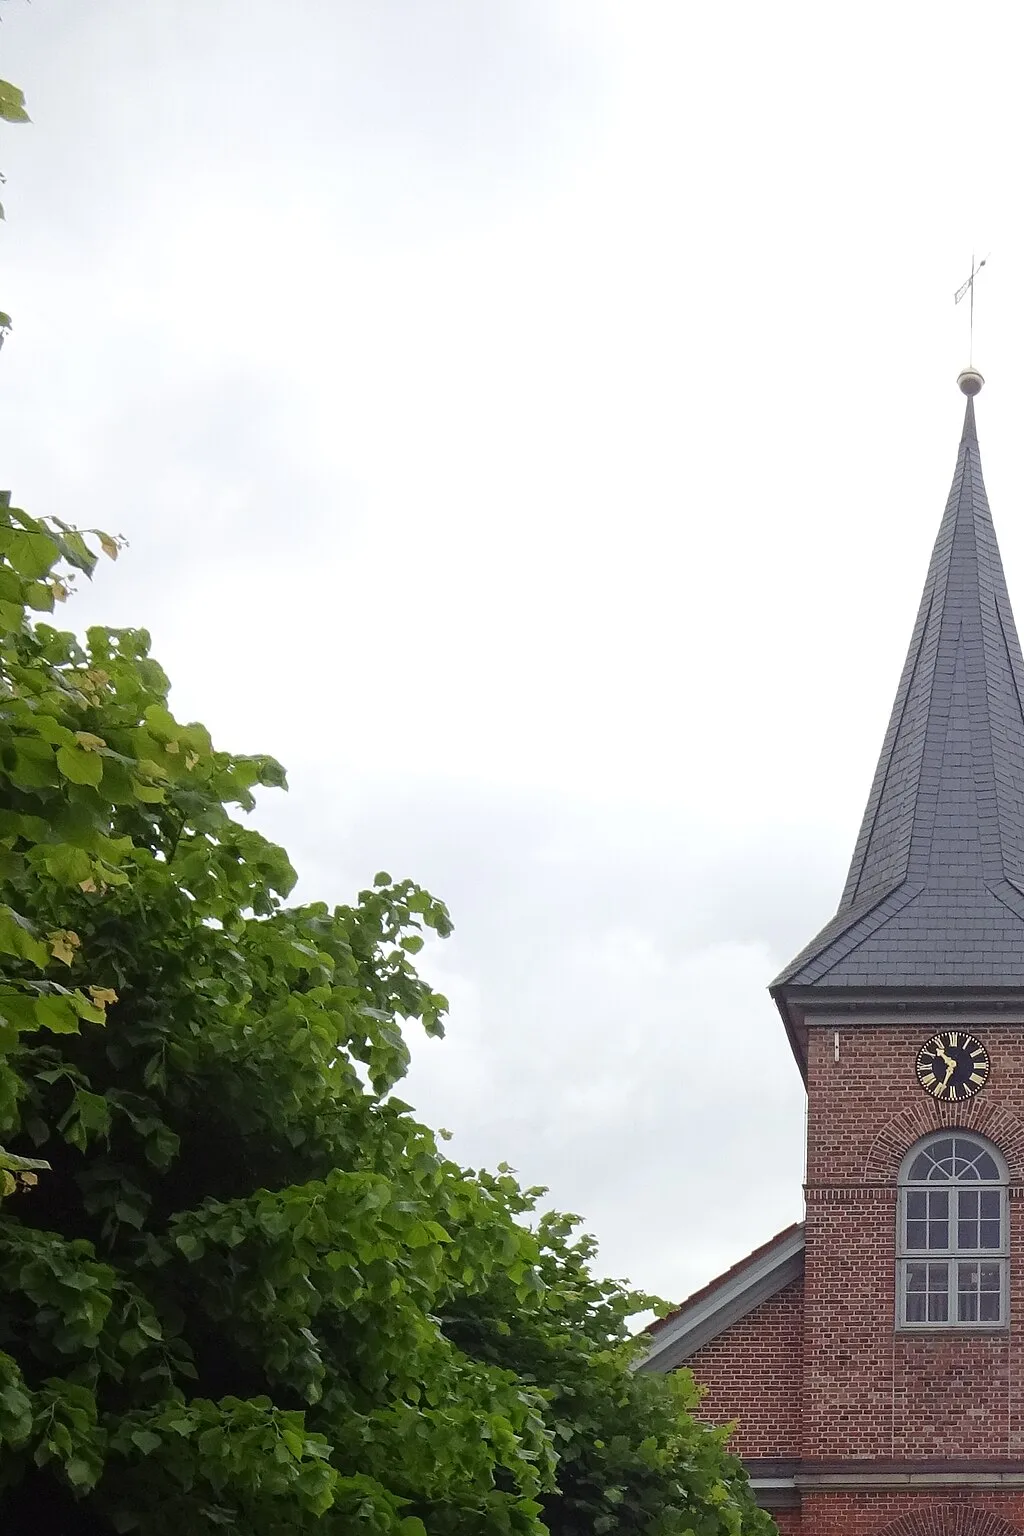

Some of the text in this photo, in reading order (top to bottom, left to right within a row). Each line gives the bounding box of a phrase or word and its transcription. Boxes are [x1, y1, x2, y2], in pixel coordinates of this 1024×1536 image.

[949, 1032, 958, 1047] XII
[962, 1037, 971, 1050] I
[923, 1048, 936, 1059] X
[970, 1048, 983, 1058] II
[918, 1062, 932, 1070] IX
[962, 1082, 972, 1094] V
